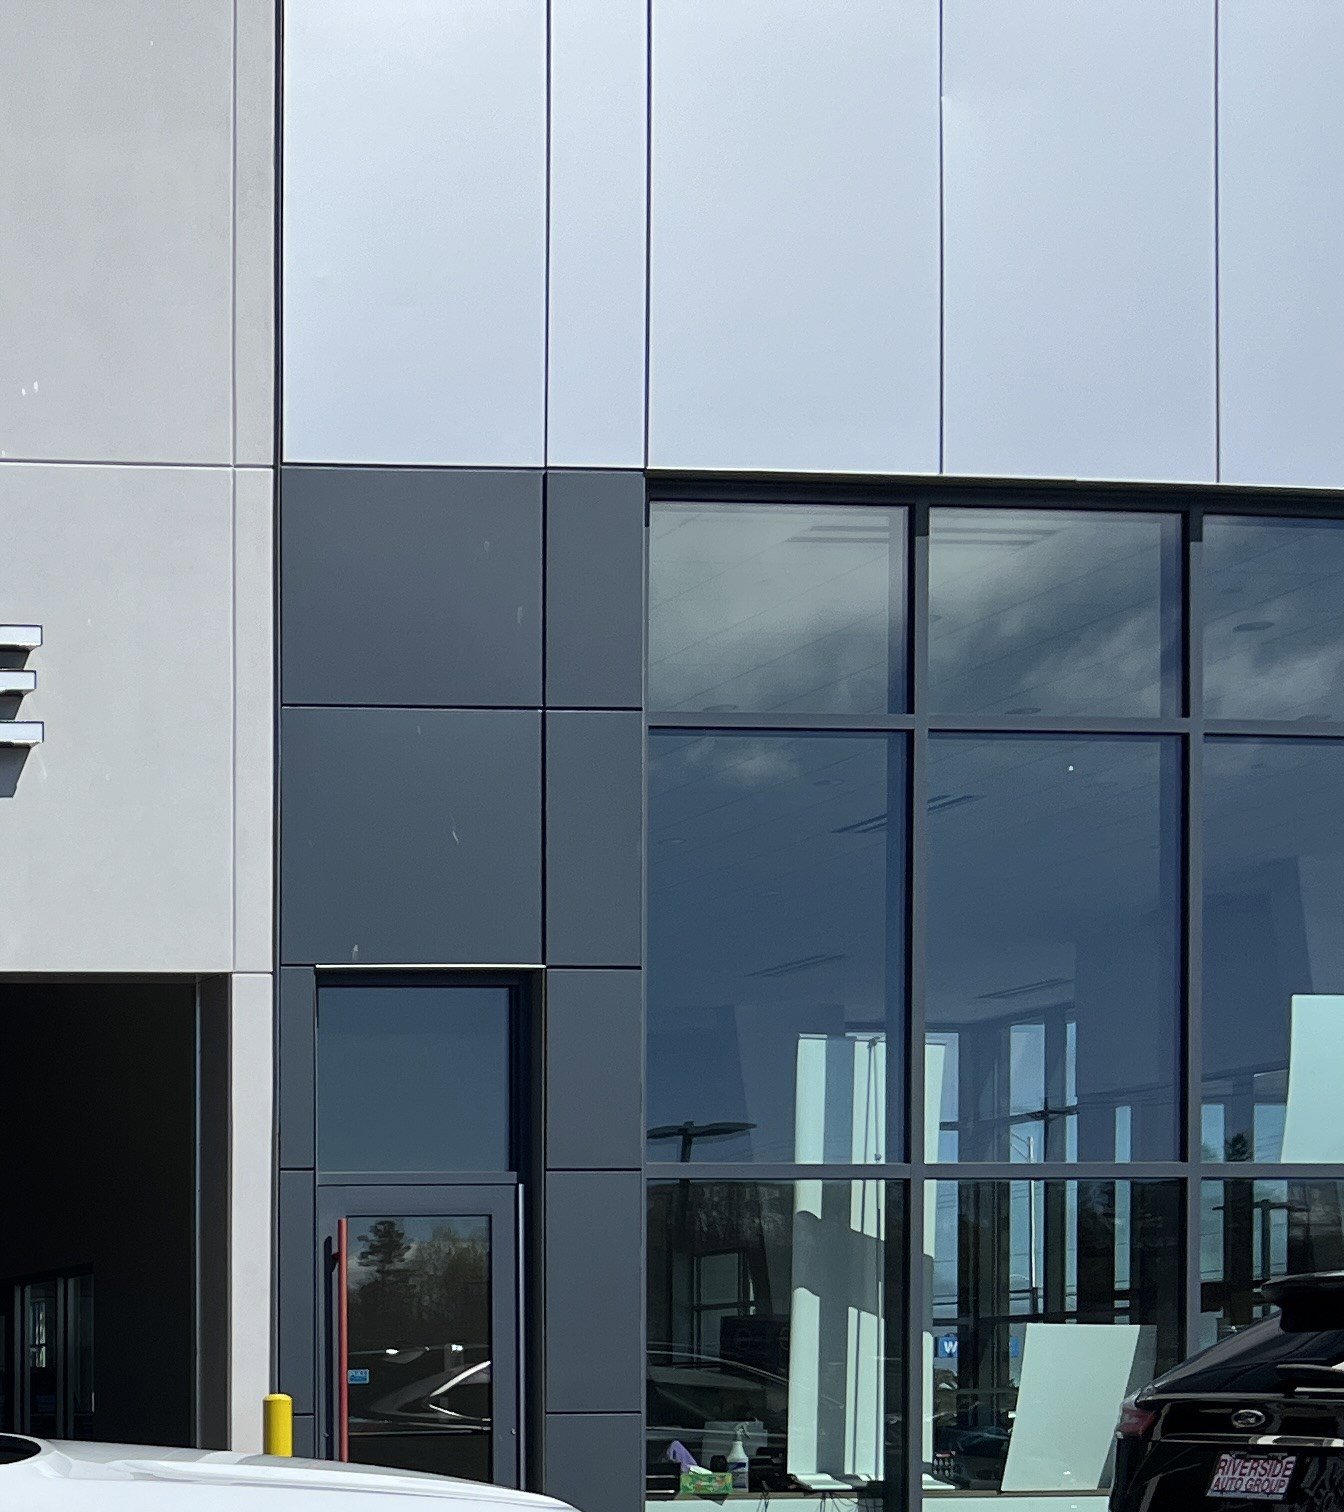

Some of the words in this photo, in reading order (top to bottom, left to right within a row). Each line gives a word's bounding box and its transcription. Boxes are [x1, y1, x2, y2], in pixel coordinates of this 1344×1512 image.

[1216, 1459, 1294, 1478] RIVERSIDE
[1213, 1477, 1243, 1491] AUTO
[1244, 1477, 1286, 1494] GROUP
